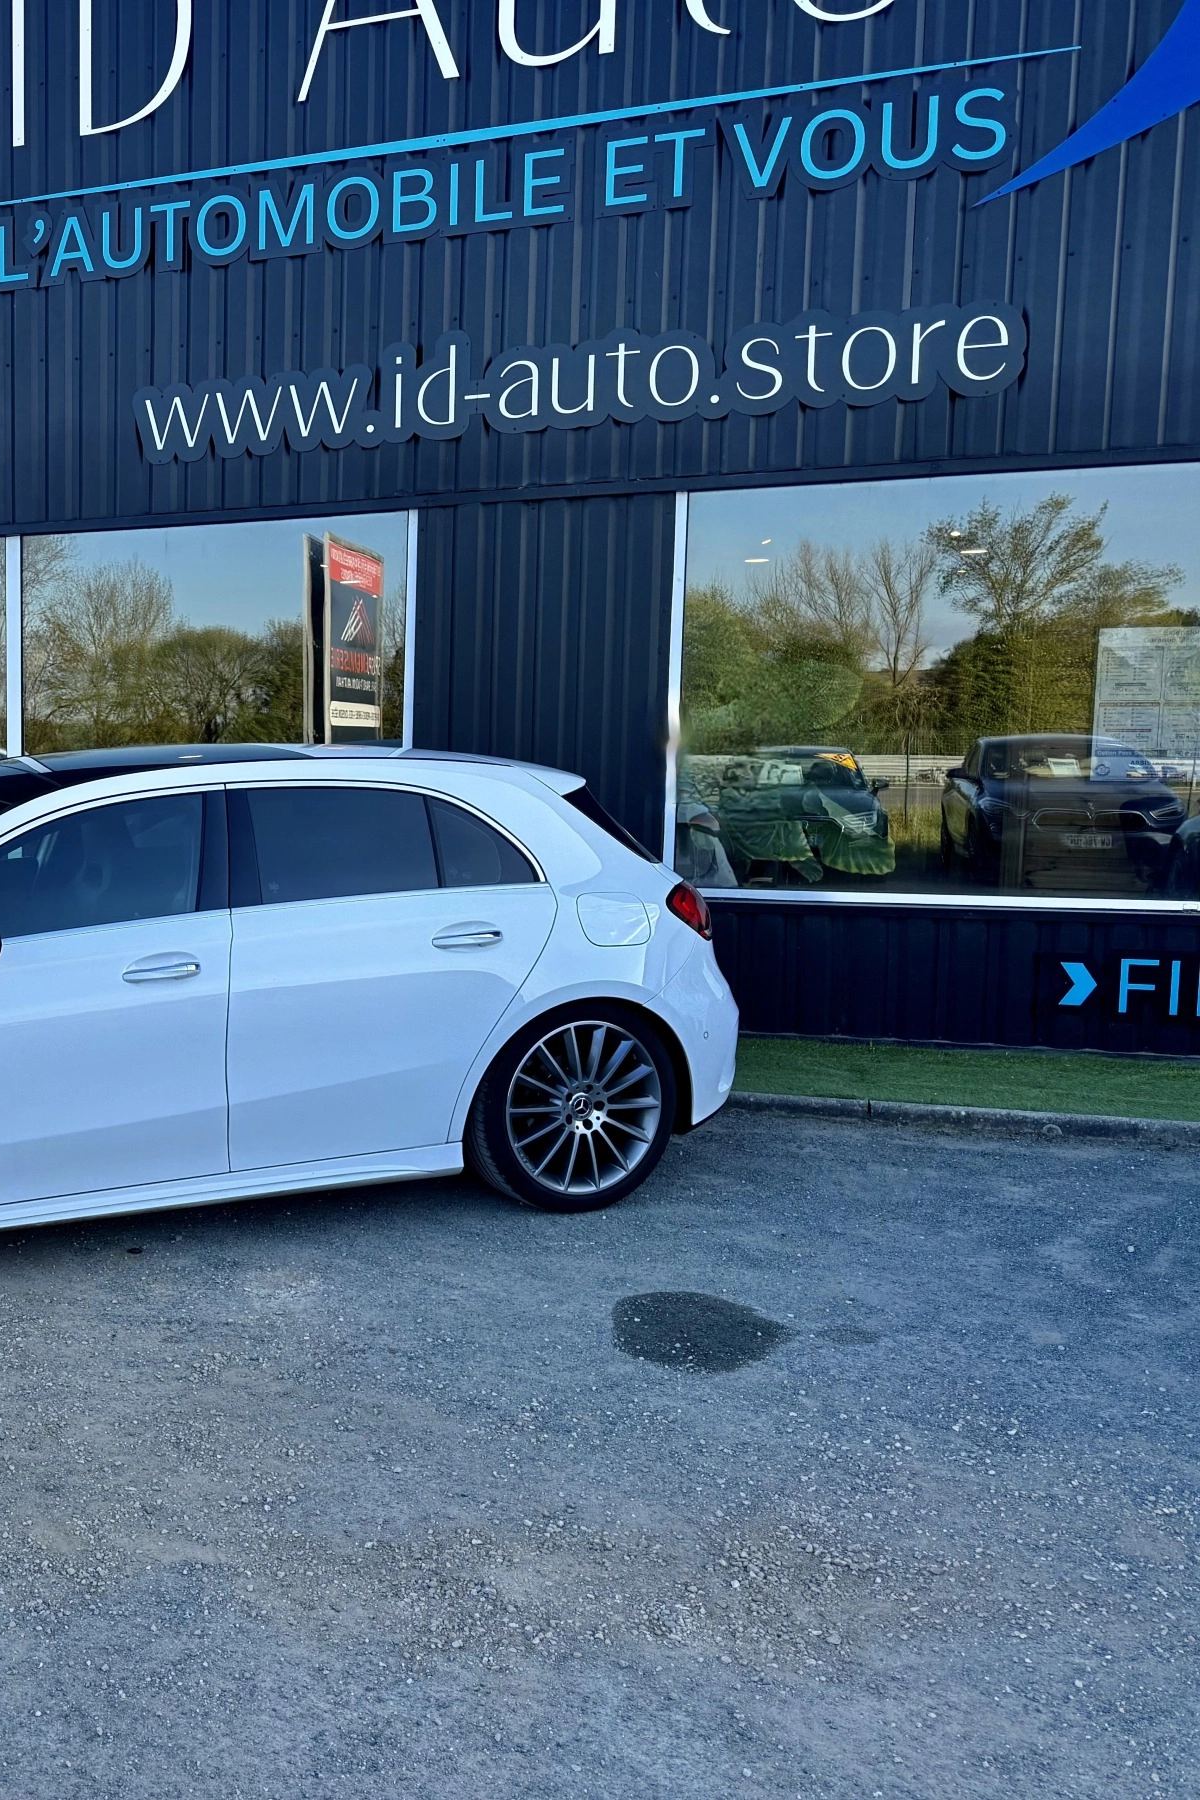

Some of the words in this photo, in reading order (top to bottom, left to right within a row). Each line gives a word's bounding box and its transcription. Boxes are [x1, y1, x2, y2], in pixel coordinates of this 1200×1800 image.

[605, 128, 706, 208] ET
[733, 87, 1008, 189] VOUS
[144, 314, 1010, 452] www.id-auto.store
[1117, 957, 1200, 1017] FI
